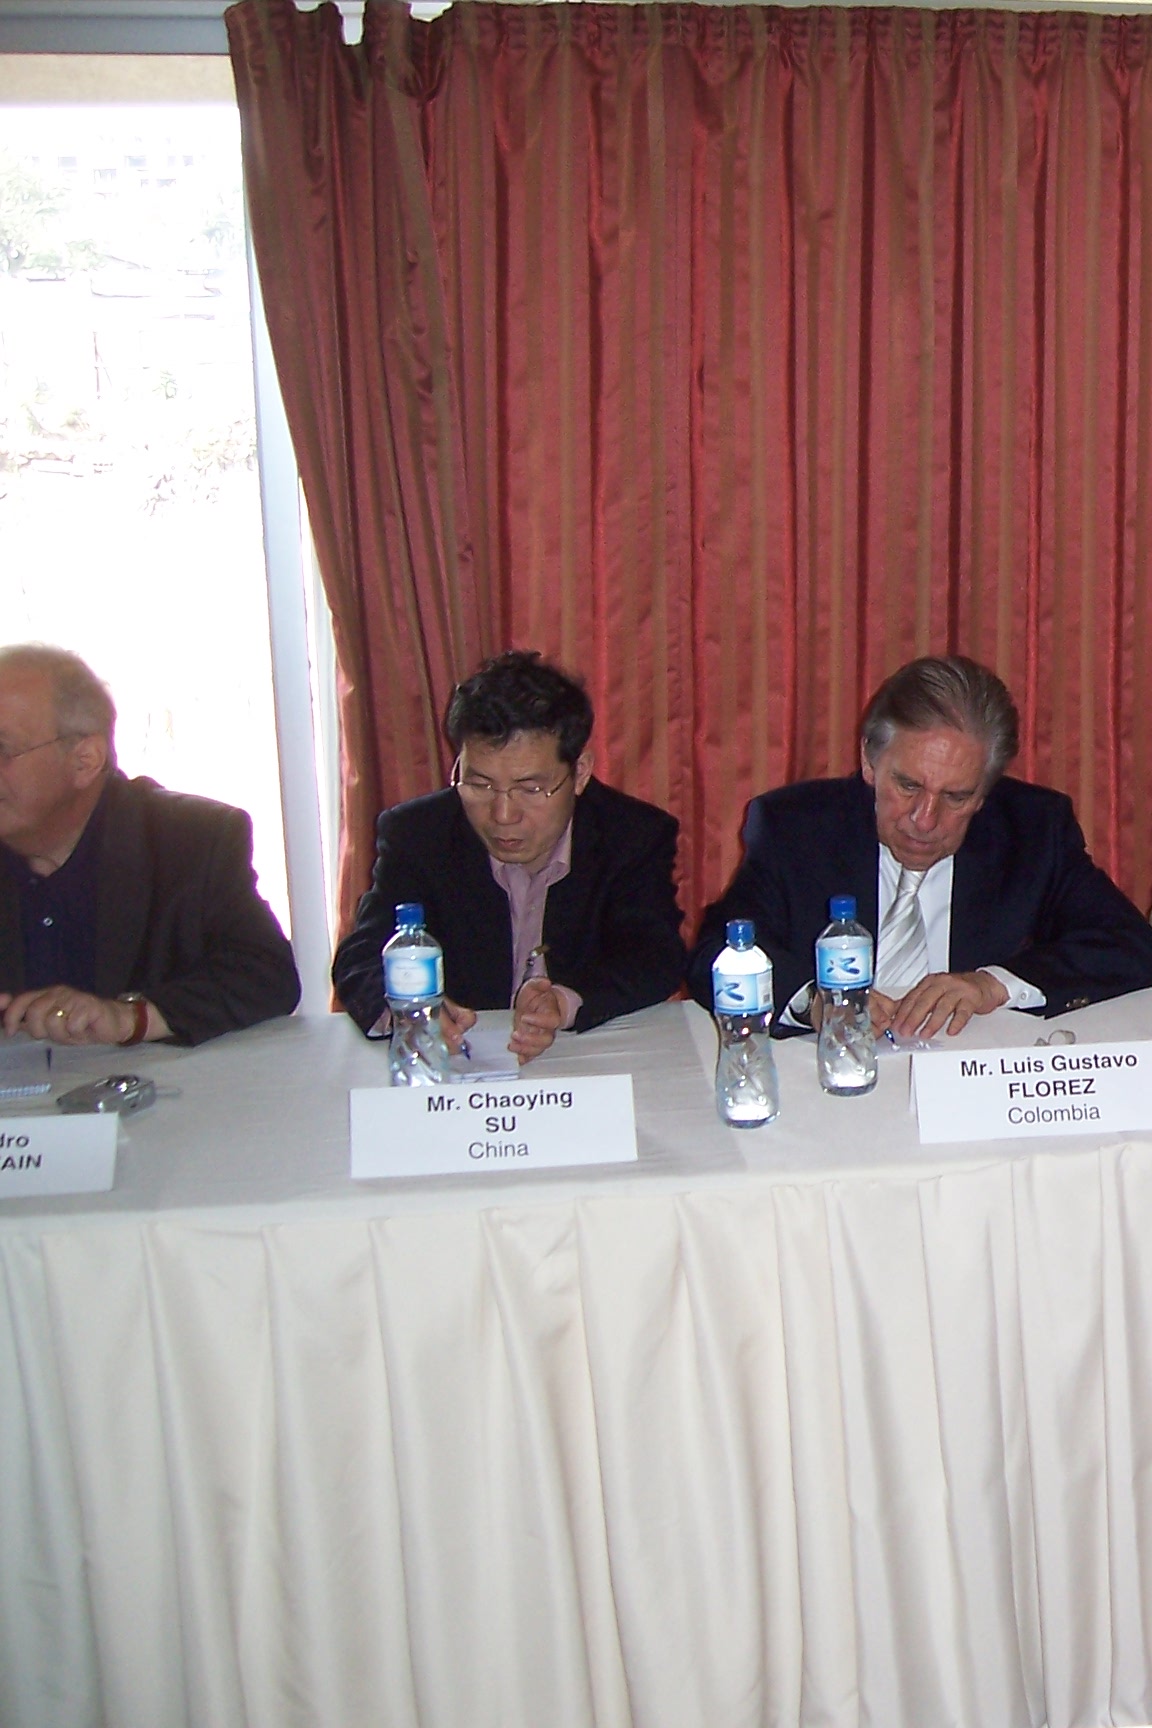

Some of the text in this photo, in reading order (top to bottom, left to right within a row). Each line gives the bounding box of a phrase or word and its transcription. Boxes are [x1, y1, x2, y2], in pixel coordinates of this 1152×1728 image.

[960, 1053, 1138, 1077] Mr. Luis Gustavo
[1008, 1078, 1096, 1099] FLOREZ
[427, 1089, 573, 1112] Mr. Chaoying
[485, 1116, 516, 1133] SU
[1008, 1103, 1101, 1125] Colombia
[468, 1141, 529, 1160] China
